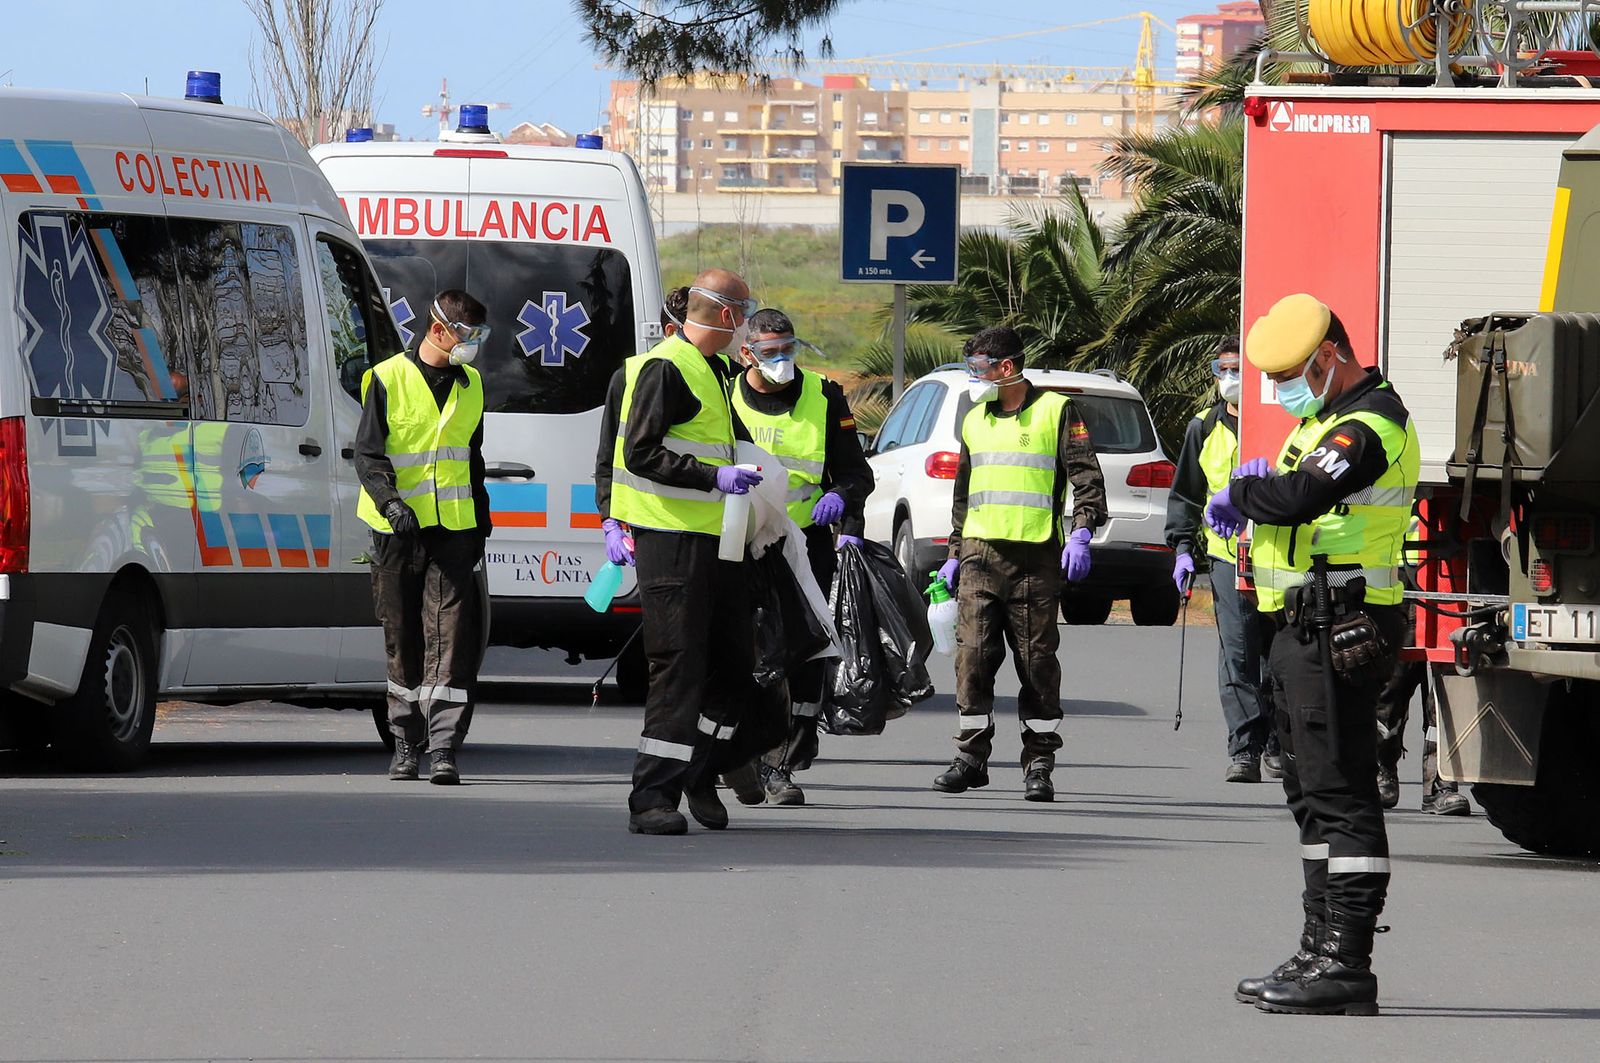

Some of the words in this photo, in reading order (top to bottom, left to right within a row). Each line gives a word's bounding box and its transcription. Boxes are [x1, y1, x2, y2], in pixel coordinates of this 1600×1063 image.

[1294, 114, 1370, 133] INCIPRESA
[115, 151, 272, 203] COLECTIVA
[338, 197, 612, 243] MBULANCIA
[869, 189, 925, 261] P
[858, 267, 864, 276] A
[865, 267, 879, 276] 150
[1301, 446, 1351, 480] PM
[516, 568, 536, 582] LA
[1516, 625, 1524, 634] E
[1527, 609, 1558, 638] ET
[1571, 610, 1594, 639] 11
